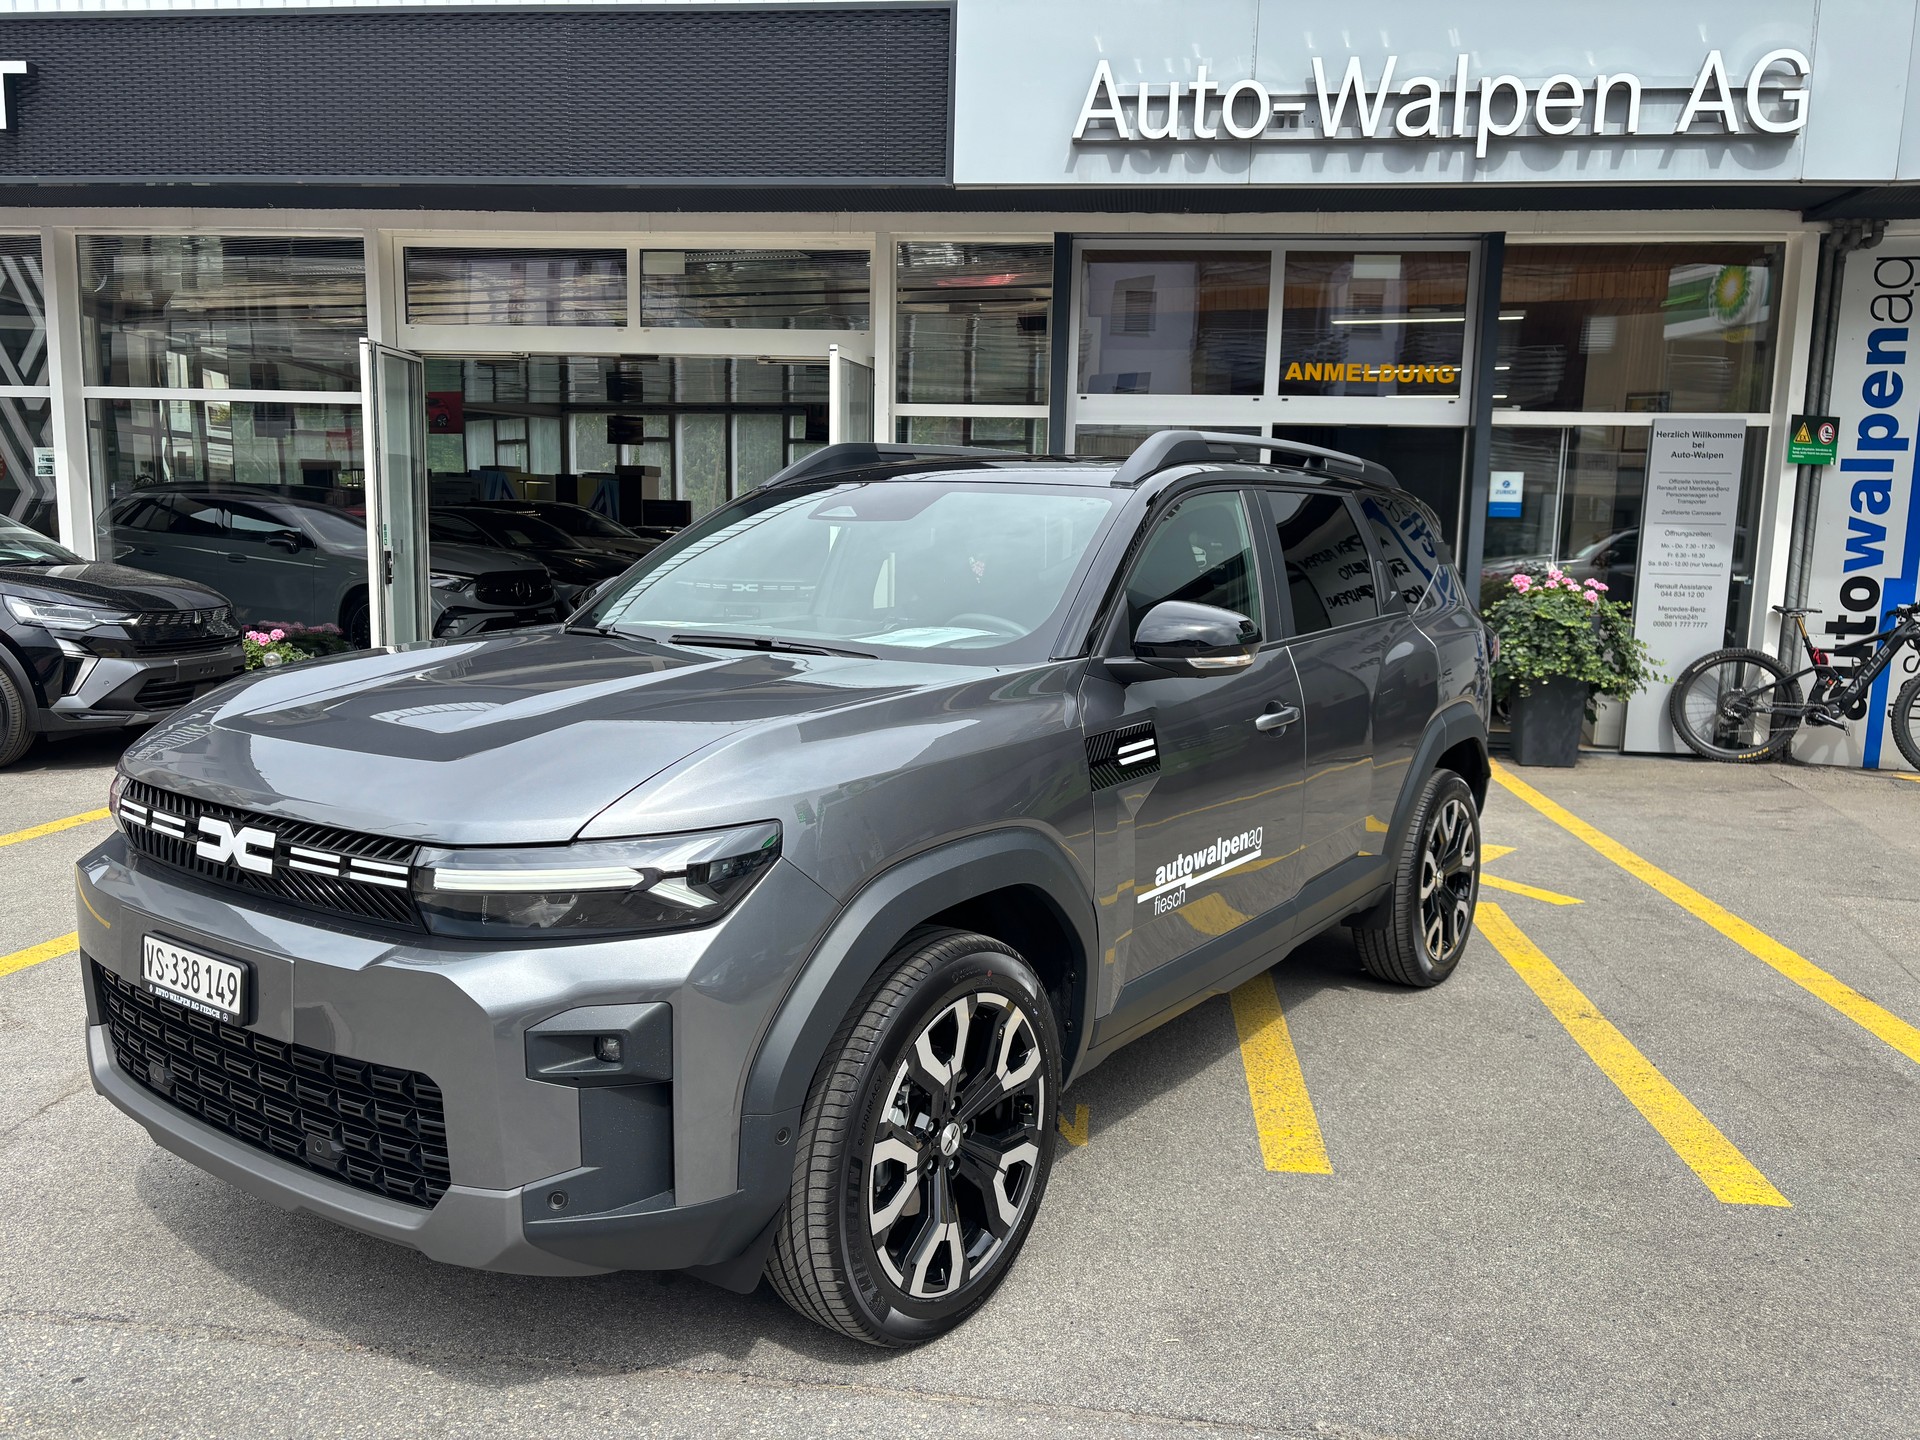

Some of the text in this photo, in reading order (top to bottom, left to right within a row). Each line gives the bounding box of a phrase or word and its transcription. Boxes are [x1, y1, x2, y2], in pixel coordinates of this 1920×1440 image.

[1072, 47, 1812, 158] Auto-Walpen AG
[1284, 362, 1456, 384] ANMELDUNG
[1692, 431, 1743, 439] Willkommen
[1671, 451, 1724, 460] Auto-Walpen
[1848, 645, 1891, 694] WALLIS
[1154, 826, 1263, 887] autowalpenag
[1154, 886, 1186, 916] fiesch
[155, 986, 220, 1018] AUTO WALPEN AG FIESCH
